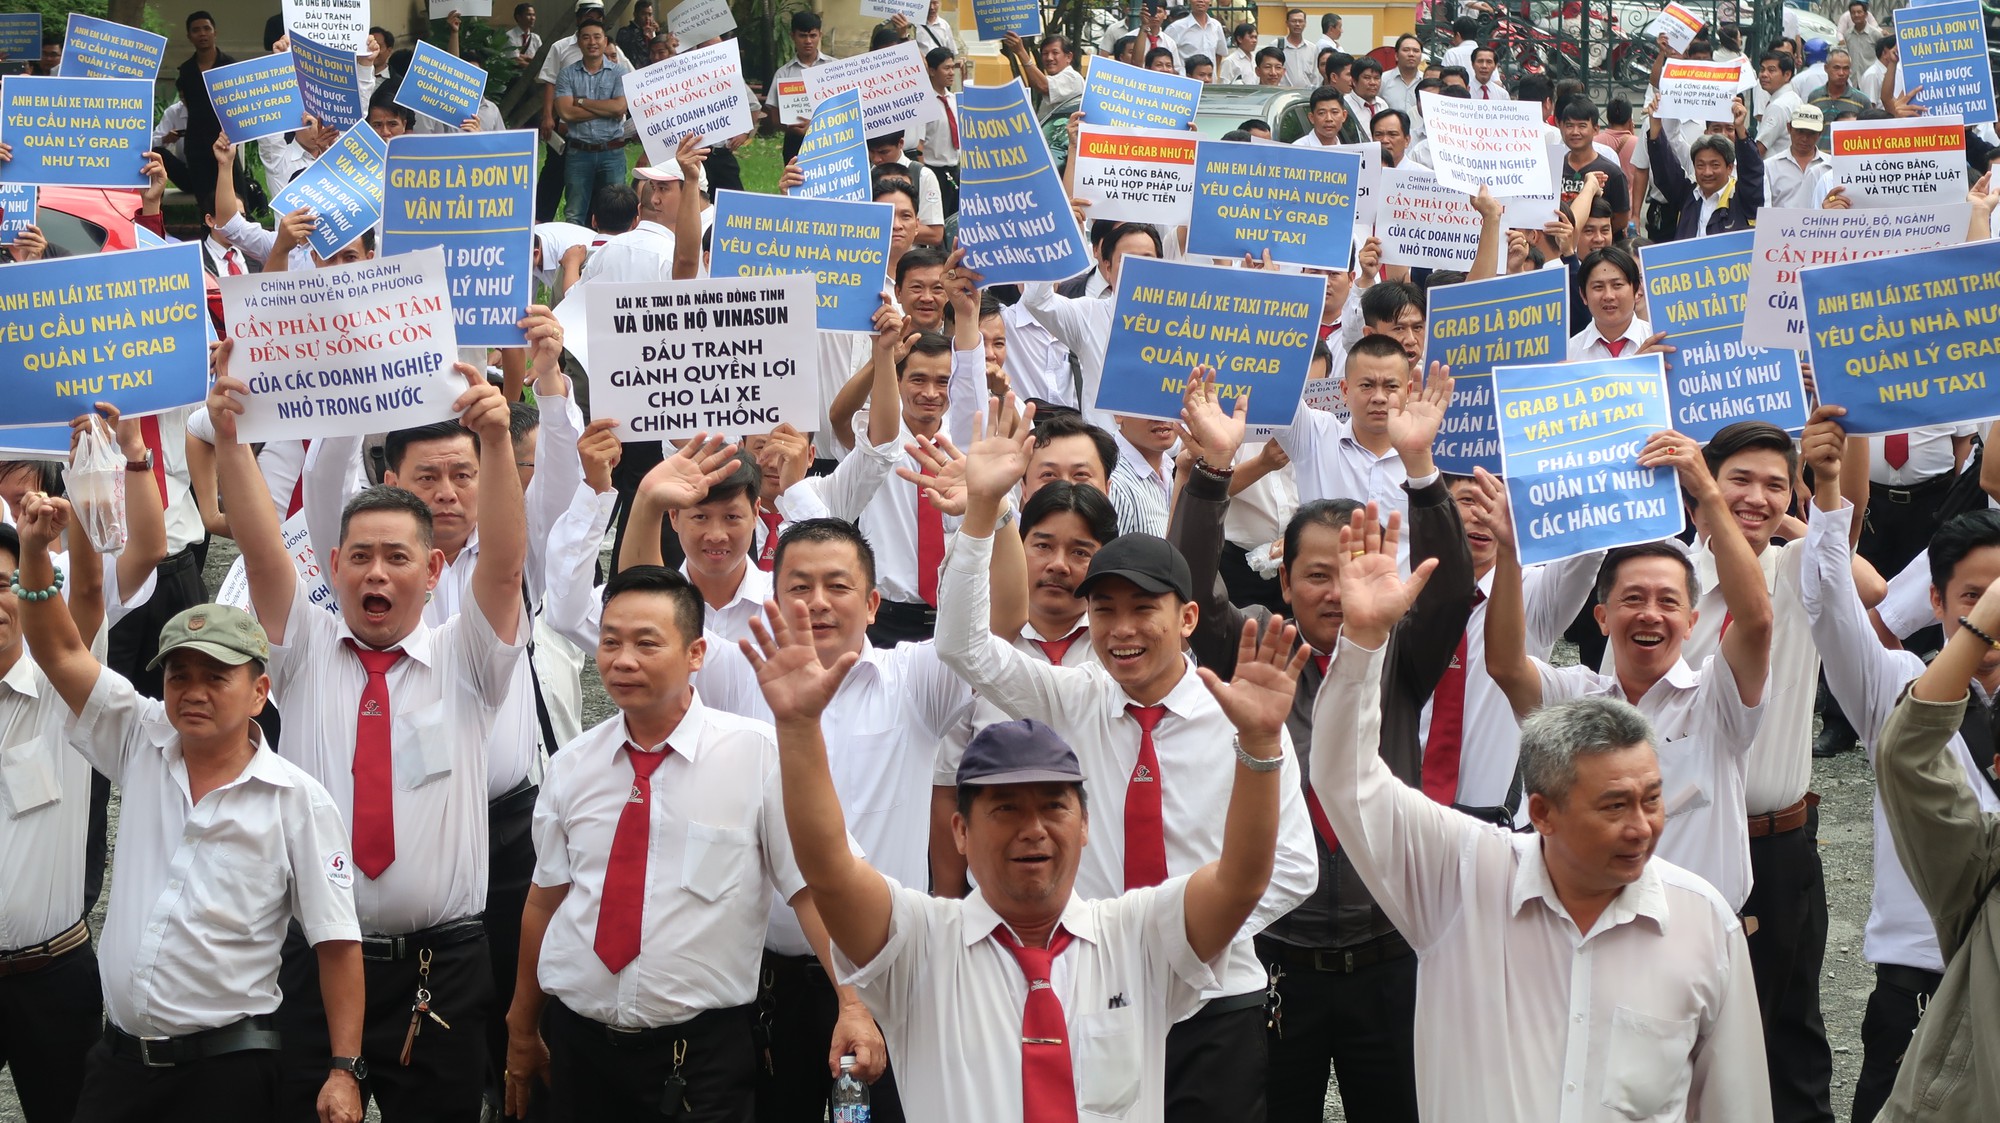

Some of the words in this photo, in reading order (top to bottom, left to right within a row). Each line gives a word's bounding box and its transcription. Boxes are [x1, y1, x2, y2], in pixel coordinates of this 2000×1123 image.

[1900, 26, 1928, 40] GRAB
[1930, 22, 1943, 36] LÀ
[1945, 21, 1967, 34] ĐƠN
[1968, 19, 1980, 33] VỊ
[1911, 42, 1932, 58] VẬN
[1933, 39, 1949, 53] TẢI
[1951, 38, 1974, 51] TAXI
[1919, 68, 1943, 84] PHẢI
[1945, 66, 1973, 81] ĐƯỢC
[12, 95, 33, 107] ANH
[35, 96, 49, 107] EM
[52, 95, 67, 108] LÁI
[69, 97, 81, 108] XE
[83, 97, 105, 109] TAXI
[106, 98, 143, 110] TP.HCM
[1916, 86, 1944, 102] QUẢN
[1946, 86, 1956, 98] LÝ
[1958, 81, 1981, 96] NHƯ
[8, 113, 33, 127] YÊU
[37, 112, 66, 128] CẦU
[70, 115, 102, 129] NHÀ
[105, 116, 146, 130] NƯỚC
[24, 133, 65, 148] QUẢN
[69, 134, 86, 148] LÝ
[89, 137, 129, 149] GRAB
[1843, 136, 1870, 151] QUẢN
[1872, 136, 1883, 149] LÝ
[1884, 137, 1911, 149] GRAB
[1914, 134, 1936, 147] NHƯ
[1938, 134, 1960, 146] TAXI
[42, 155, 75, 167] NHƯ
[77, 156, 110, 168] TAXI
[1206, 161, 1229, 174] ANH
[1232, 163, 1247, 175] EM
[1249, 163, 1266, 177] LÁI
[1268, 166, 1282, 178] XE
[1283, 167, 1307, 181] TAXI
[1308, 170, 1347, 185] TP.HCM
[1860, 160, 1872, 172] LÀ
[1875, 160, 1904, 171] CÔNG
[1907, 159, 1939, 170] BẰNG,
[1841, 173, 1853, 184] LÀ
[1855, 172, 1876, 184] PHÙ
[1879, 174, 1902, 184] HỢP
[1904, 170, 1932, 181] PHÁP
[1935, 169, 1961, 182] LUẬT
[1201, 181, 1229, 196] YÊU
[1233, 180, 1264, 199] CẦU
[1268, 187, 1301, 202] NHÀ
[1305, 191, 1350, 207] NƯỚC
[1865, 184, 1879, 195] VÀ
[1881, 184, 1910, 196] THỰC
[1912, 182, 1937, 193] TIỄN
[1217, 204, 1260, 220] QUẢN
[1264, 207, 1283, 221] LÝ
[1286, 211, 1328, 226] GRAB
[1235, 228, 1269, 241] NHƯ
[1272, 230, 1306, 245] TAXI
[244, 295, 258, 307] VÀ
[261, 294, 297, 307] CHÍNH
[300, 287, 344, 304] QUYỀN
[348, 285, 369, 298] ĐỊA
[372, 274, 423, 293] PHƯƠNG
[261, 279, 295, 296] CHÍNH
[299, 274, 333, 291] PHỦ,
[332, 271, 354, 285] BỘ,
[357, 264, 401, 281] NGÀNH
[616, 297, 632, 309] LÁI
[635, 297, 648, 309] XE
[651, 295, 673, 308] TAXI
[676, 293, 691, 306] ĐÀ
[694, 290, 723, 305] NẴNG
[727, 288, 757, 303] ĐỒNG
[760, 289, 785, 302] TÌNH
[235, 315, 272, 338] CẦN
[277, 313, 327, 336] PHẢI
[332, 306, 391, 335] QUAN
[395, 296, 442, 318] TÂM
[613, 312, 637, 333] VÀ
[642, 310, 678, 333] ỦNG
[684, 308, 707, 332] HỘ
[713, 306, 788, 328] VINASUN
[250, 338, 290, 362] ĐẾN
[295, 339, 320, 361] SỰ
[326, 334, 383, 356] SỐNG
[389, 323, 432, 345] CÒN
[642, 338, 686, 362] ĐẤU
[692, 339, 763, 358] TRANH
[248, 372, 282, 395] CỦA
[285, 370, 316, 390] CÁC
[318, 365, 377, 387] DOANH
[381, 351, 443, 381] NGHIỆP
[610, 366, 677, 387] GIÀNH
[684, 357, 756, 387] QUYỀN
[763, 358, 795, 380] LỢI
[277, 395, 313, 419] NHỎ
[316, 396, 372, 416] TRONG
[375, 386, 424, 412] NƯỚC
[648, 390, 694, 408] CHO
[701, 384, 730, 404] LÁI
[736, 385, 761, 402] XE
[1505, 396, 1559, 419] GRAB
[1563, 387, 1588, 408] LÀ
[1590, 381, 1633, 403] ĐƠN
[1636, 381, 1658, 398] VỊ
[630, 411, 697, 432] CHÍNH
[703, 403, 779, 427] THỐNG
[1523, 419, 1564, 443] VẬN
[1567, 409, 1598, 431] TẢI
[1600, 402, 1644, 424] TAXI
[1537, 451, 1584, 473] PHẢI
[1587, 440, 1643, 465] ĐƯỢC
[1529, 474, 1583, 506] QUẢN
[1587, 469, 1608, 494] LÝ
[1529, 512, 1565, 540] CÁC
[1567, 503, 1621, 532] HÃNG
[1623, 498, 1666, 520] TAXI
